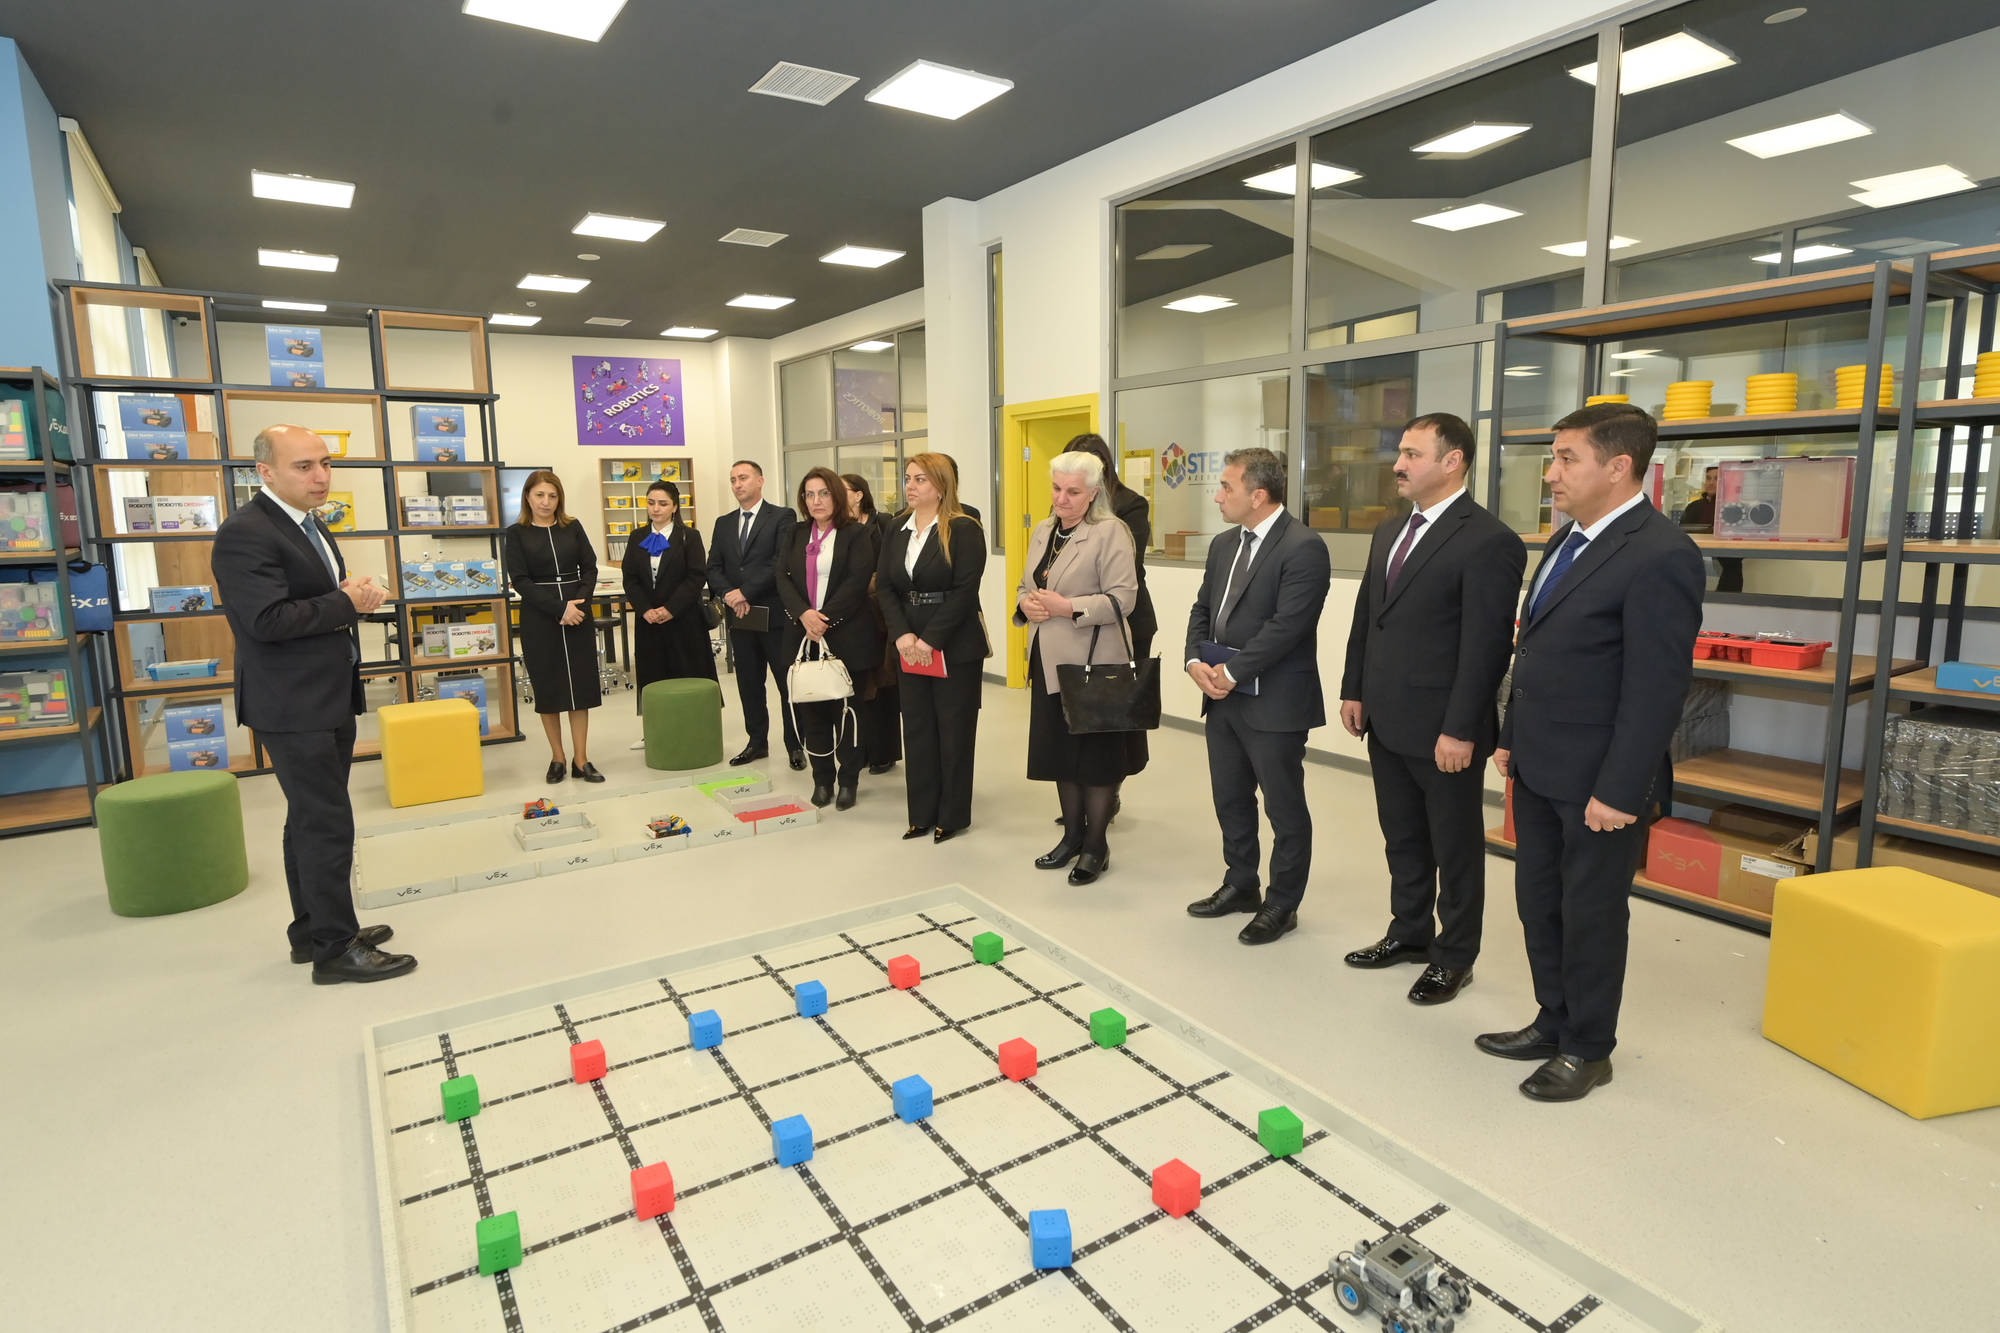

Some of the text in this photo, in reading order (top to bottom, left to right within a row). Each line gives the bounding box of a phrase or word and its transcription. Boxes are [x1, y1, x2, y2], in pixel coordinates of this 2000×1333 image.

[603, 383, 660, 417] ROBOTICS
[71, 594, 95, 609] EX
[1972, 675, 2000, 688] VE
[734, 786, 751, 794] VEX
[540, 818, 560, 827] VEX
[779, 817, 797, 825] VEX
[714, 829, 732, 838] VEX
[644, 842, 663, 852] VEX
[567, 856, 589, 865] VEX
[486, 871, 508, 881] VEX
[397, 887, 422, 897] VEX
